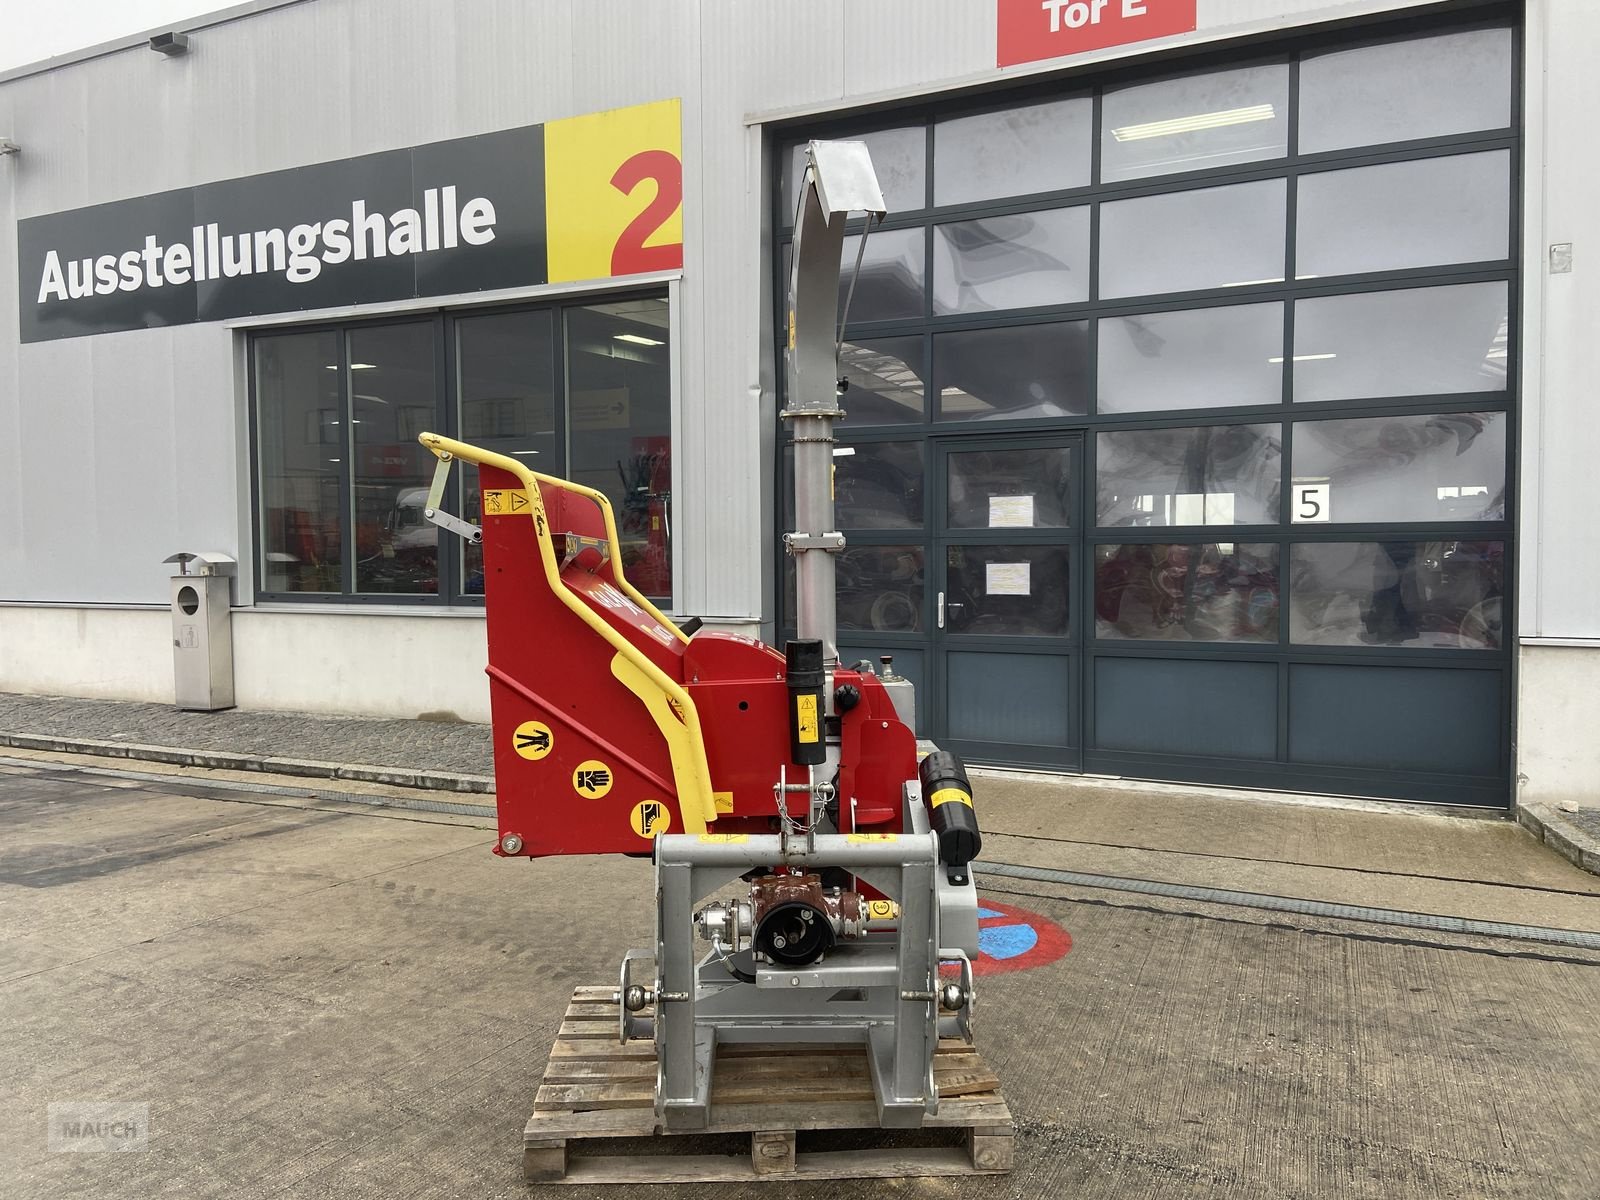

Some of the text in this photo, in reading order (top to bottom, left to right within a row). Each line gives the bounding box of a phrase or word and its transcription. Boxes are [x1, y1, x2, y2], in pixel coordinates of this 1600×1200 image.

[1042, 0, 1108, 32] Tor
[37, 149, 683, 304] Ausstellungshalle 2
[1299, 489, 1321, 519] 5
